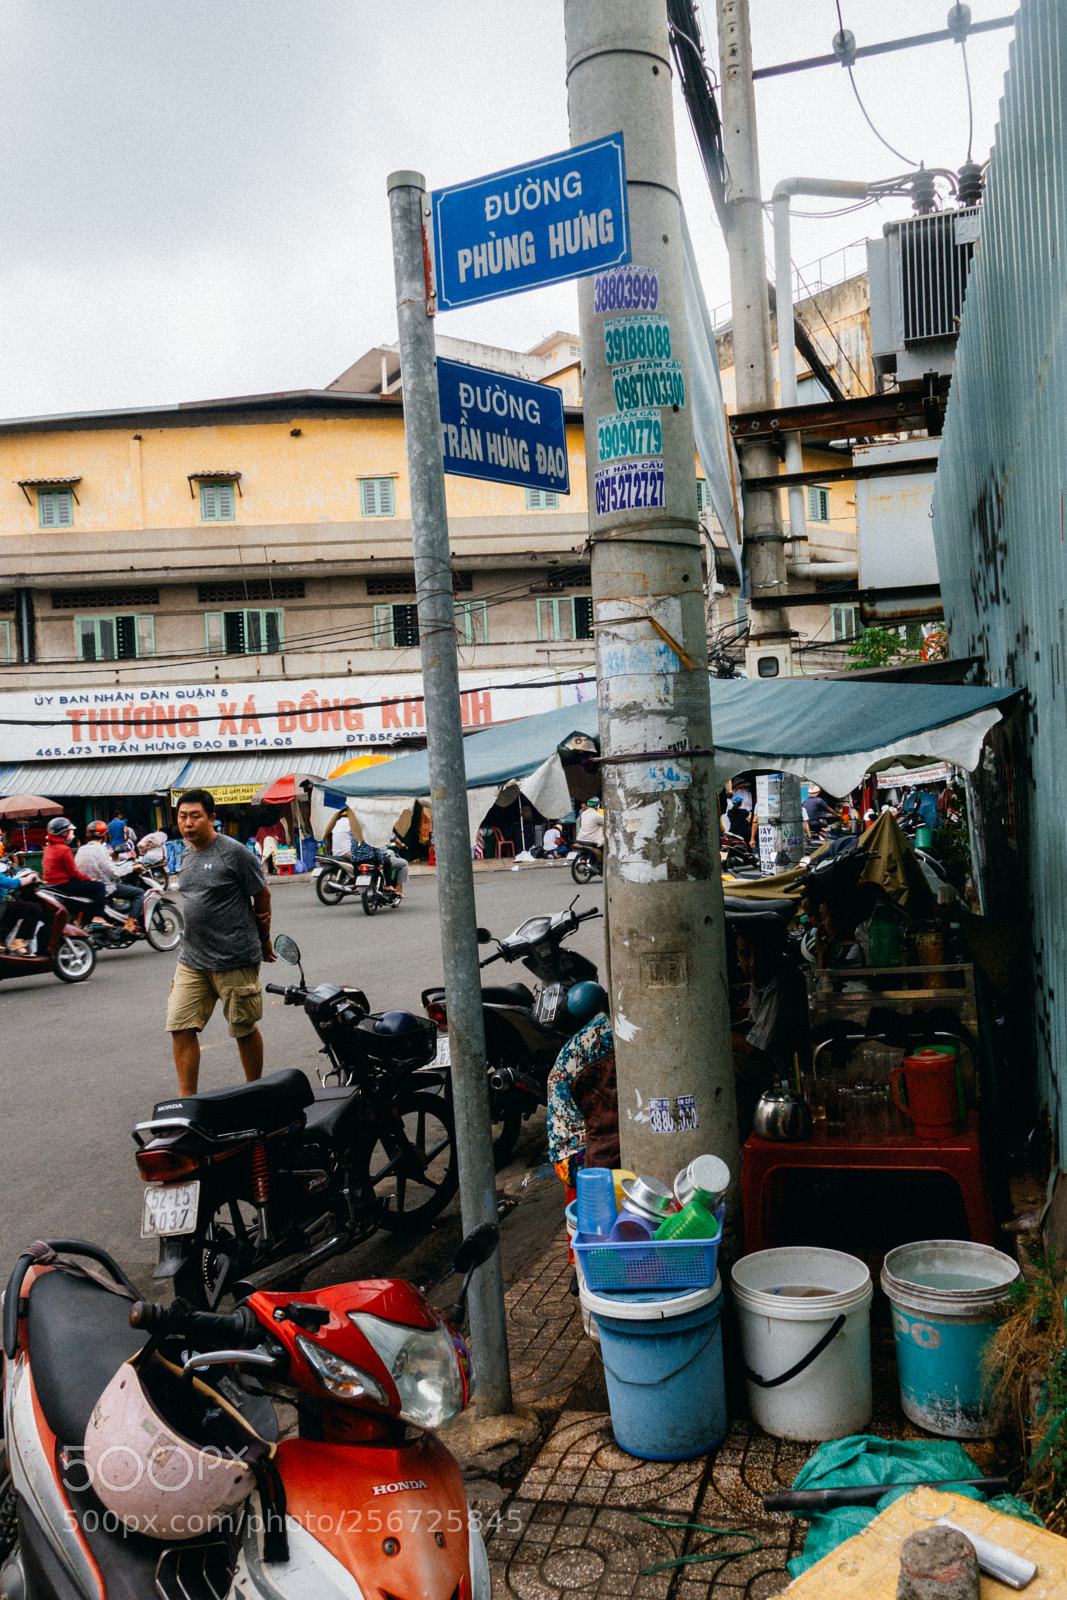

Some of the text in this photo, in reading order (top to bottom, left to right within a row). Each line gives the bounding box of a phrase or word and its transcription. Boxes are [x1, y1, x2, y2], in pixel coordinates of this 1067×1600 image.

[484, 171, 583, 222] ĐƯỜNG
[457, 208, 615, 284] PHÙNG HƯNG
[458, 382, 541, 425] ĐƯỜNG
[440, 409, 566, 484] TRẦN HƯNG ĐẠO
[60, 694, 89, 704] BAN
[94, 691, 134, 703] NHÂN
[140, 689, 170, 701] DÂN
[176, 687, 216, 700] QUẬN
[220, 688, 229, 697] 5
[65, 701, 200, 742] THƯƠNG
[218, 694, 262, 735] XÁ
[381, 688, 493, 729] KHH
[99, 741, 139, 754] TRẦN
[145, 741, 187, 752] HƯNG
[193, 740, 223, 751] ĐẠO
[229, 739, 238, 748] B
[157, 1103, 183, 1112] HONDA
[148, 1208, 190, 1232] 9037
[372, 1480, 429, 1496] HONDA
